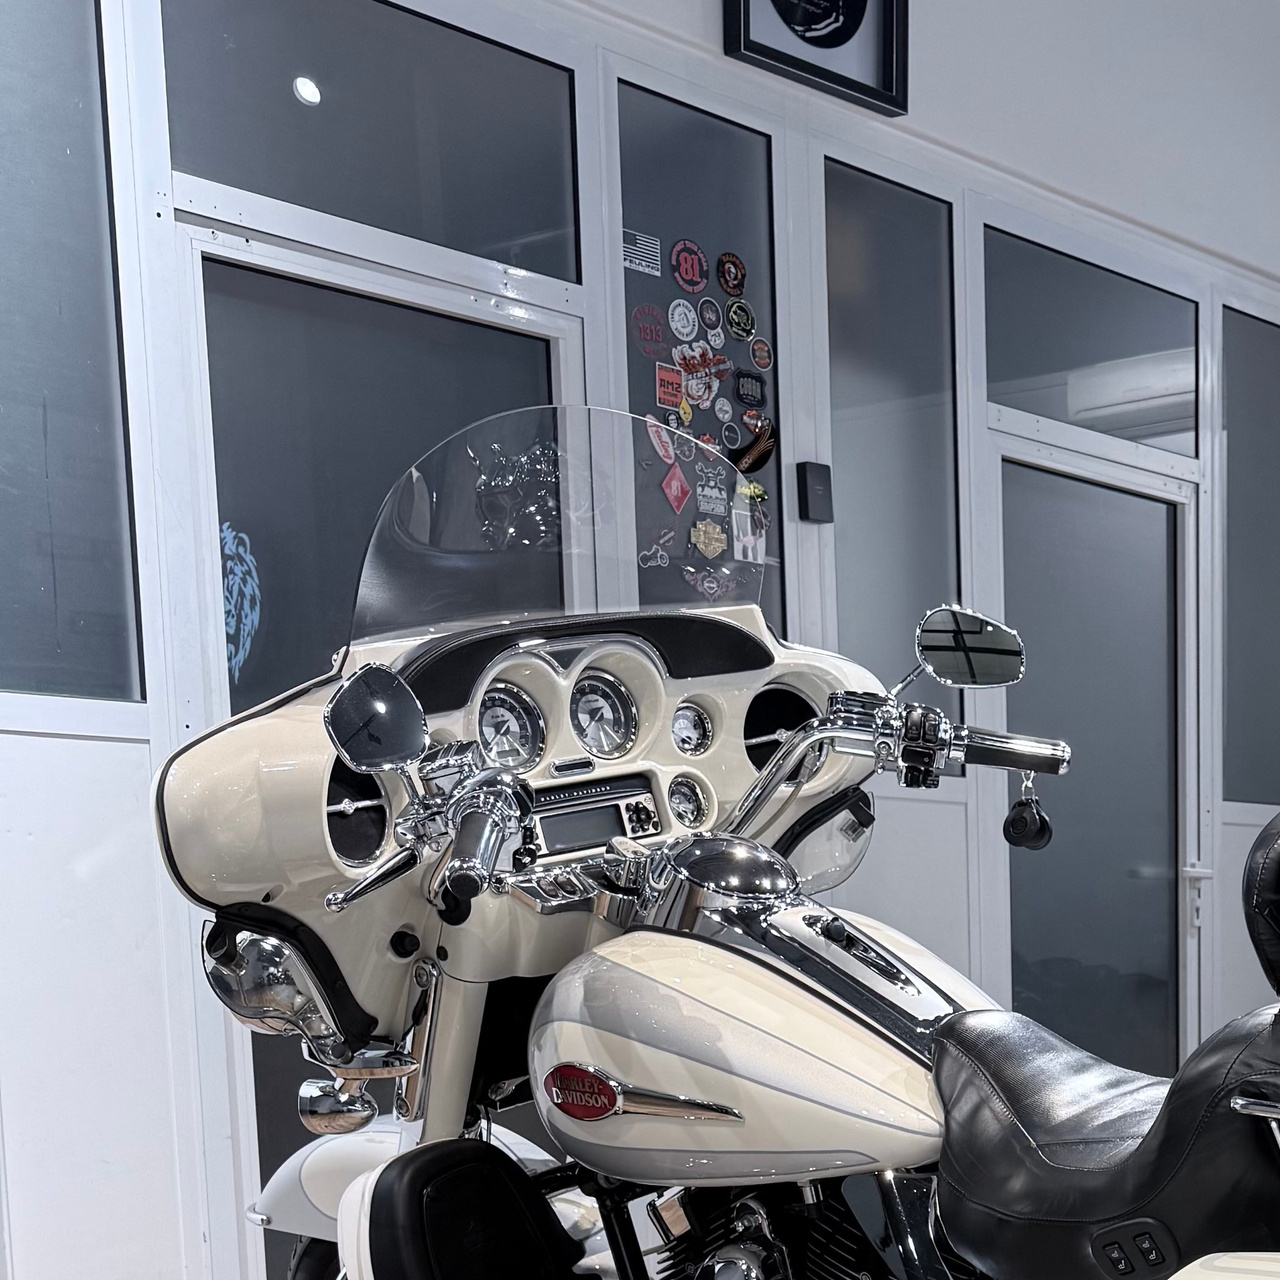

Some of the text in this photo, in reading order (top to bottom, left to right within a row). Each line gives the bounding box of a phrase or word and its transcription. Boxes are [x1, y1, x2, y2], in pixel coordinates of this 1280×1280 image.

[623, 257, 660, 272] FEULING
[679, 252, 701, 282] 81
[639, 323, 663, 343] 1313
[671, 480, 682, 497] 81
